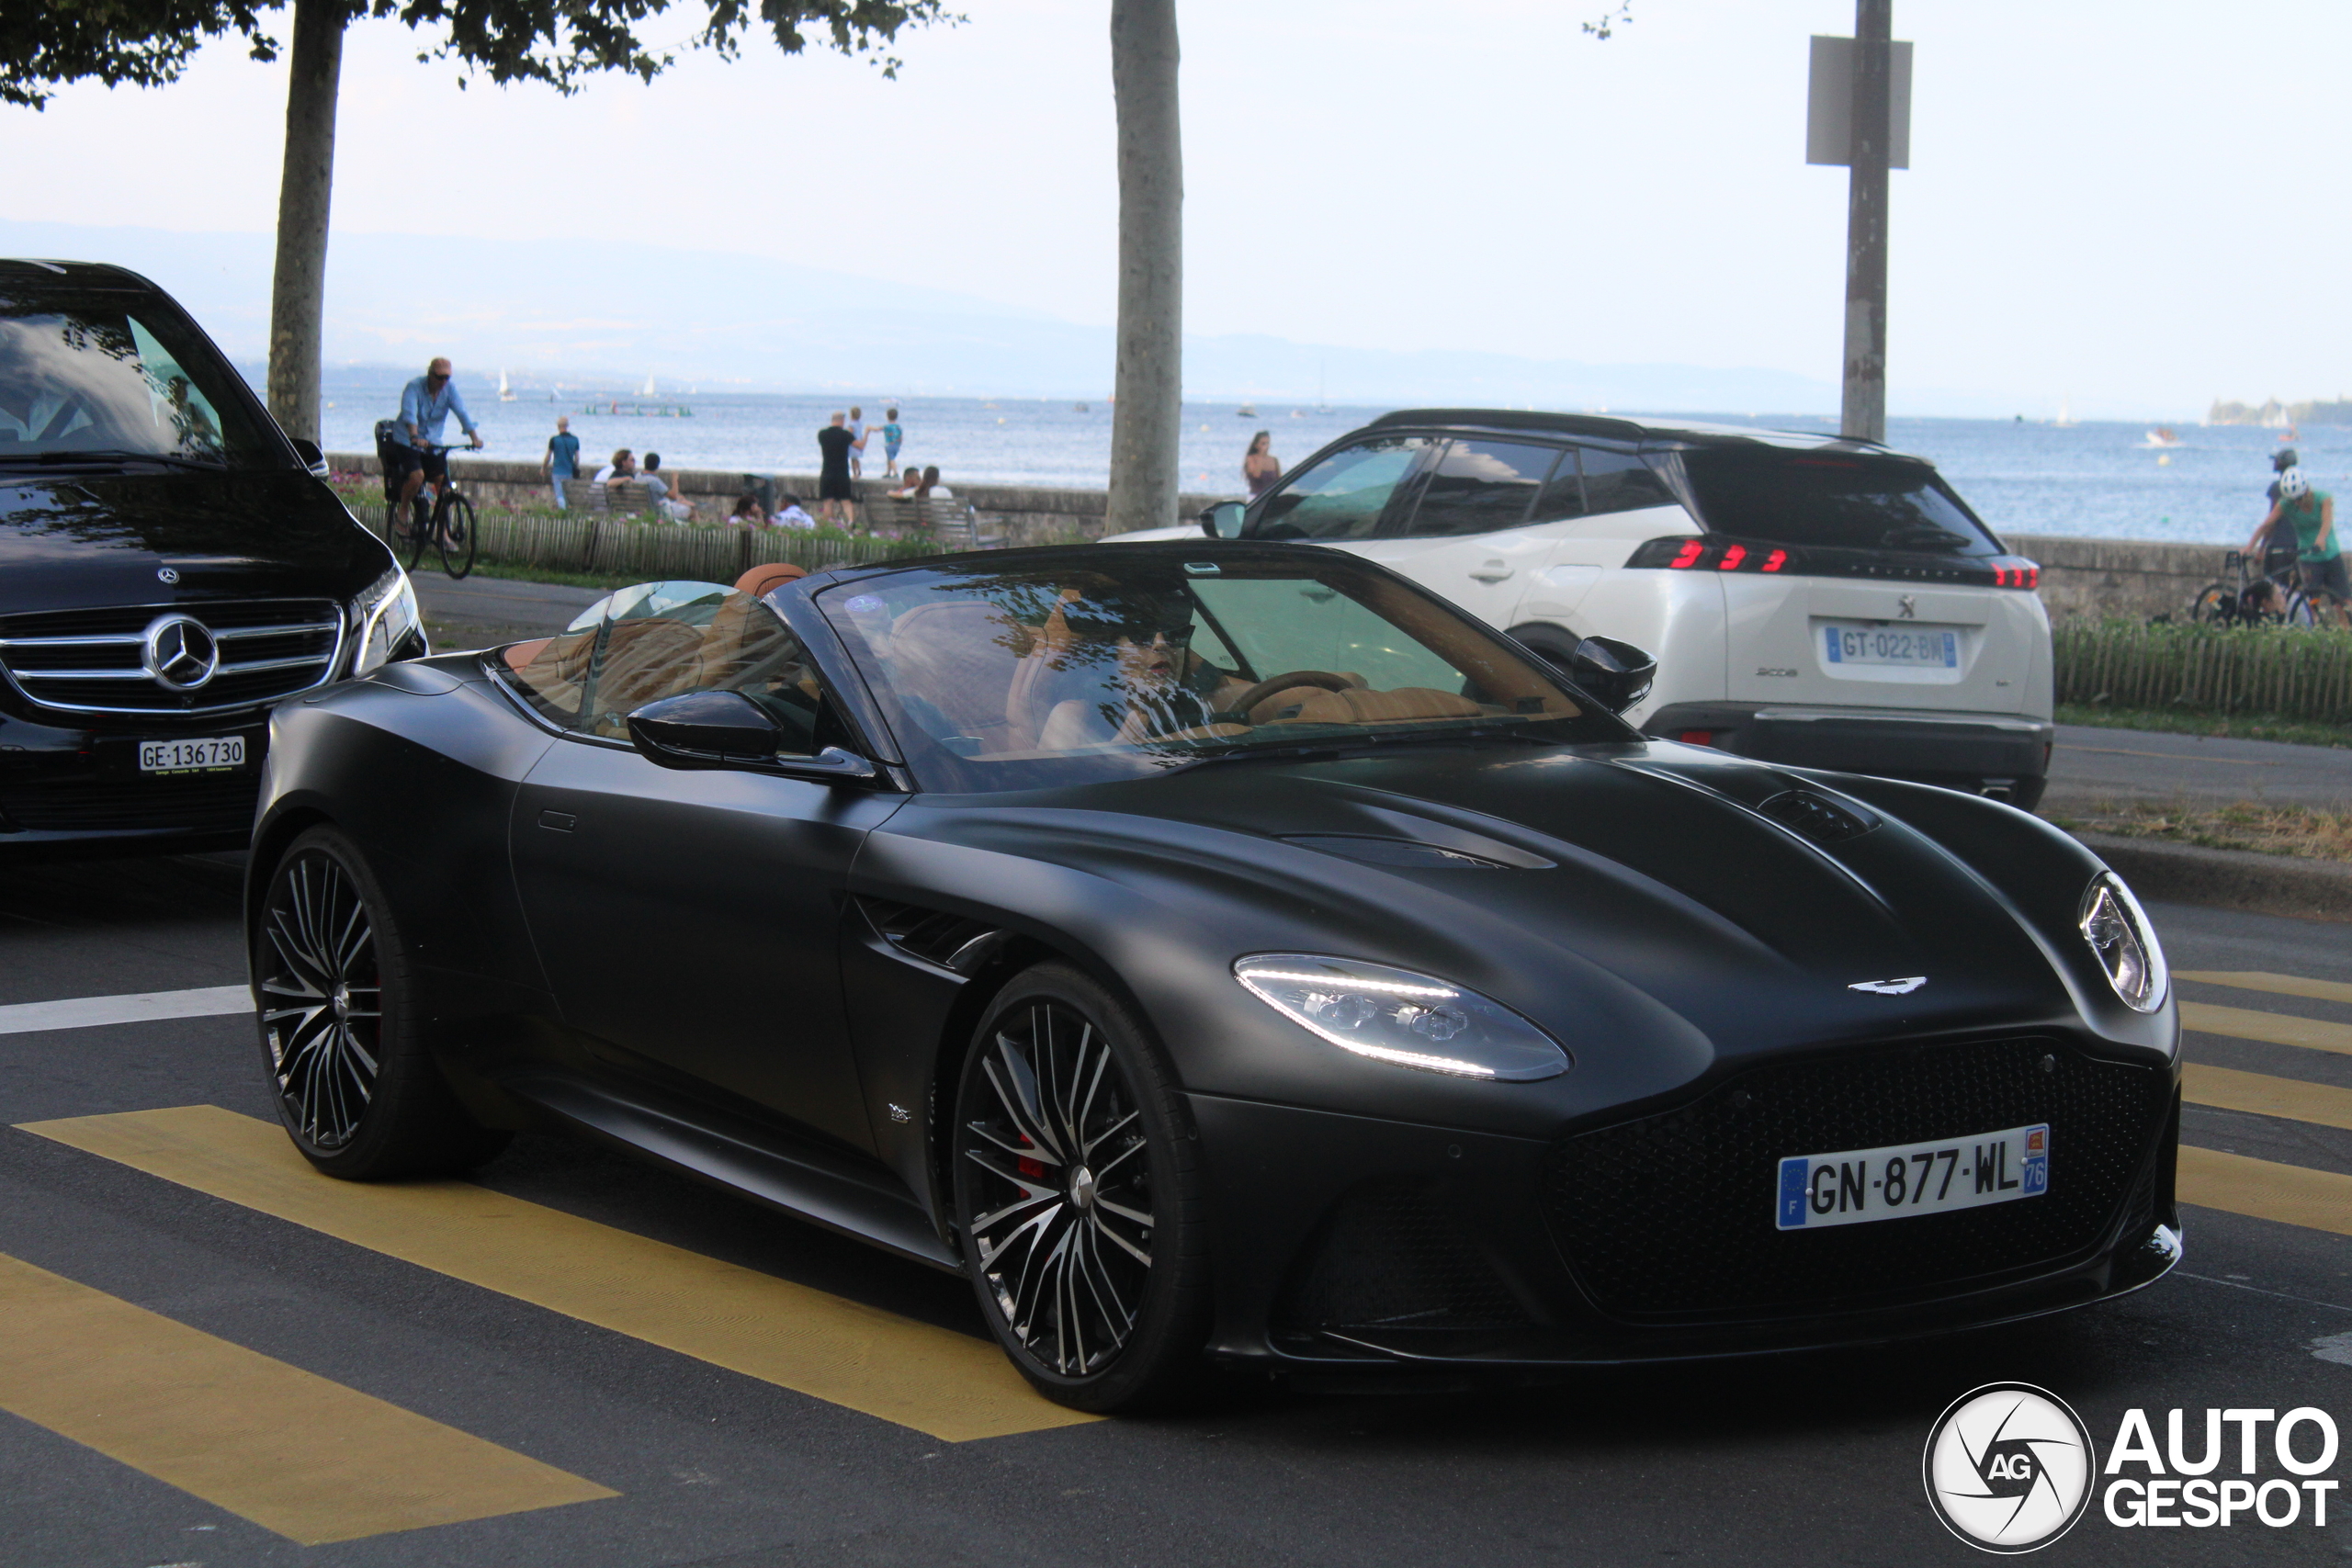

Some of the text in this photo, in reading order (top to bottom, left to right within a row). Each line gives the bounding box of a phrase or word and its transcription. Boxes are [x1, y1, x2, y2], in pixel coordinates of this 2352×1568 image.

[1811, 1141, 2018, 1214] GN-877-WL
[2026, 1162, 2044, 1187] 76
[1789, 1201, 1797, 1215] F
